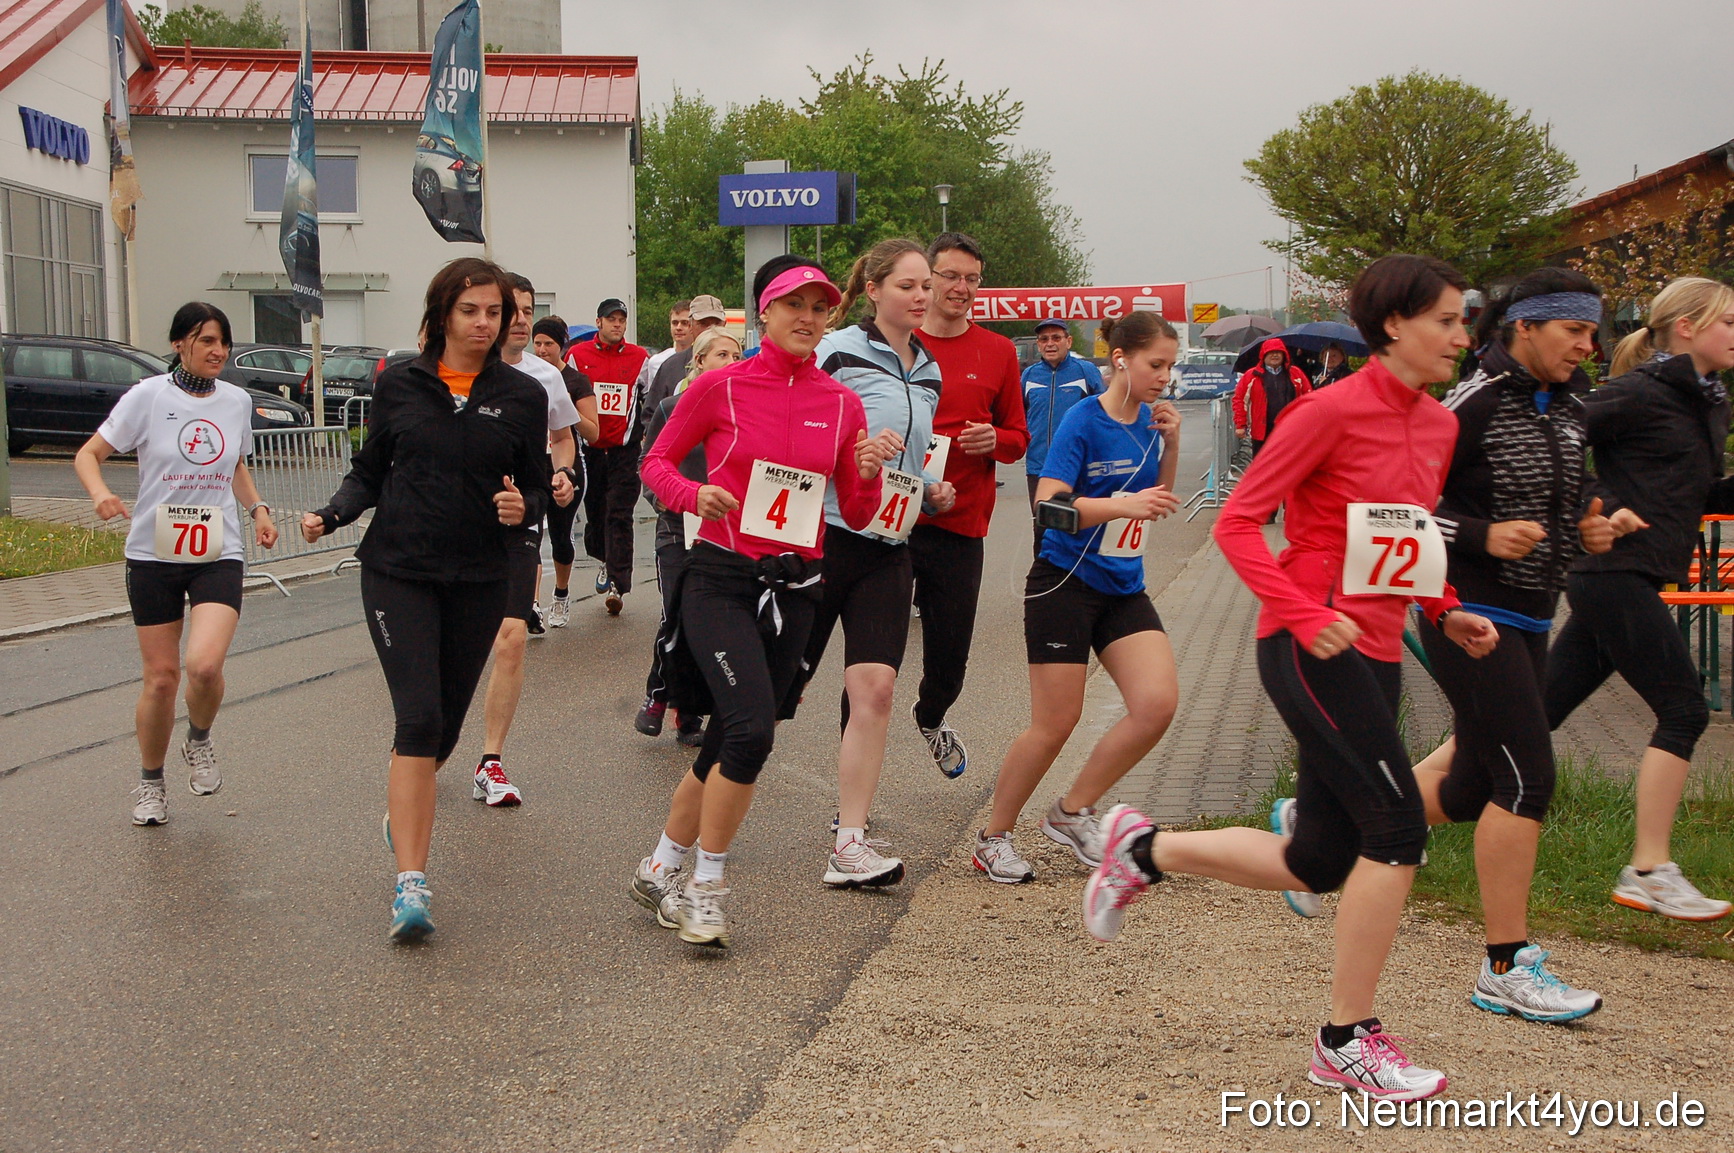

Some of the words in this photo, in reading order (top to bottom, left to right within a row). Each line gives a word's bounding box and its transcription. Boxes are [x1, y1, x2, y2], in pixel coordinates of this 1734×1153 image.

[18, 105, 90, 166] VOLVO
[729, 187, 820, 208] VOLVO
[601, 393, 622, 412] 82
[804, 420, 827, 429] CRAFT
[162, 473, 195, 481] LAUFEN
[214, 473, 232, 483] HER
[764, 475, 798, 489] WERBUNG
[765, 466, 799, 481] MEYER
[887, 471, 912, 486] MEYER
[886, 480, 910, 492] WERBUNG
[168, 506, 199, 515] MEYER
[765, 488, 790, 530] 4
[878, 492, 910, 532] 41
[1368, 508, 1411, 520] MEYER
[173, 523, 208, 557] 70
[1116, 519, 1144, 550] 76
[1367, 536, 1420, 588] 72
